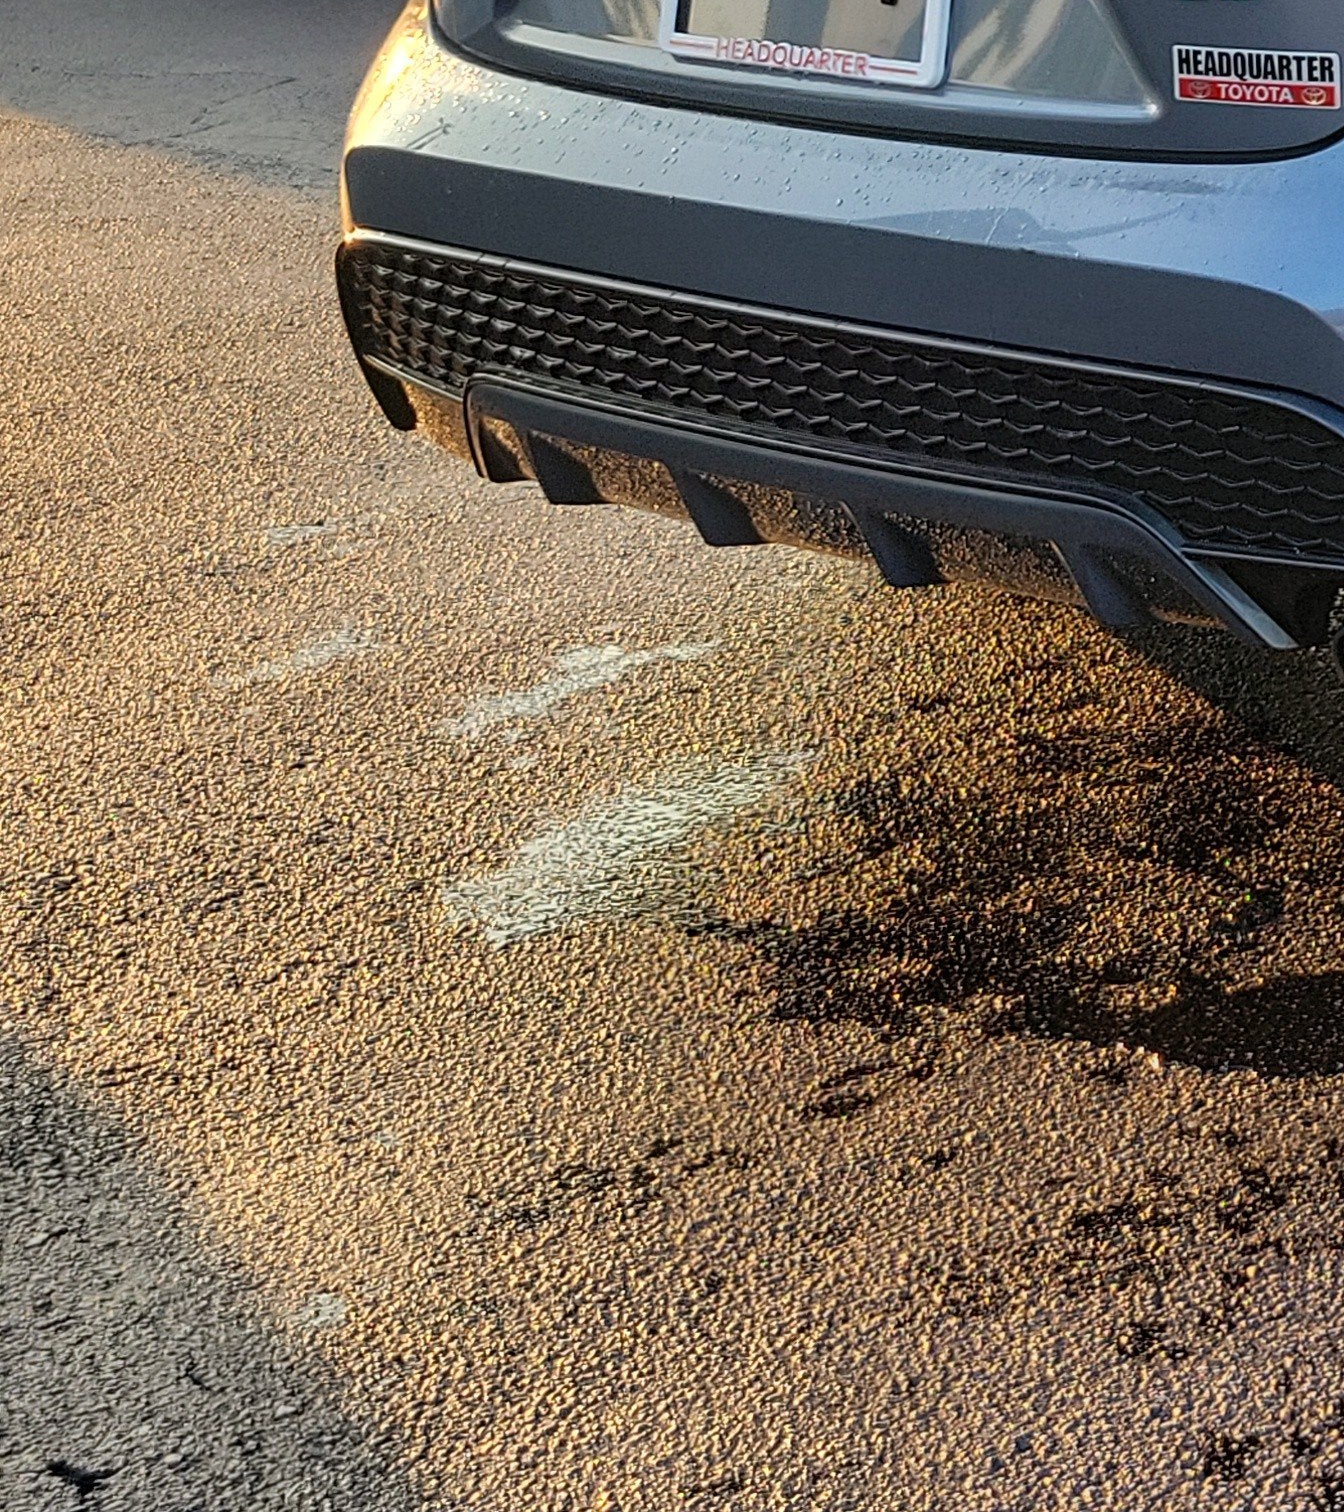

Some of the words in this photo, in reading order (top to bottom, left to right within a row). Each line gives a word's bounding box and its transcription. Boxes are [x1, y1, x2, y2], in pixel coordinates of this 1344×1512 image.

[715, 37, 869, 76] HEADQUARTER
[1177, 48, 1335, 83] HEADQUARTER
[1217, 82, 1294, 103] TOYOTA
